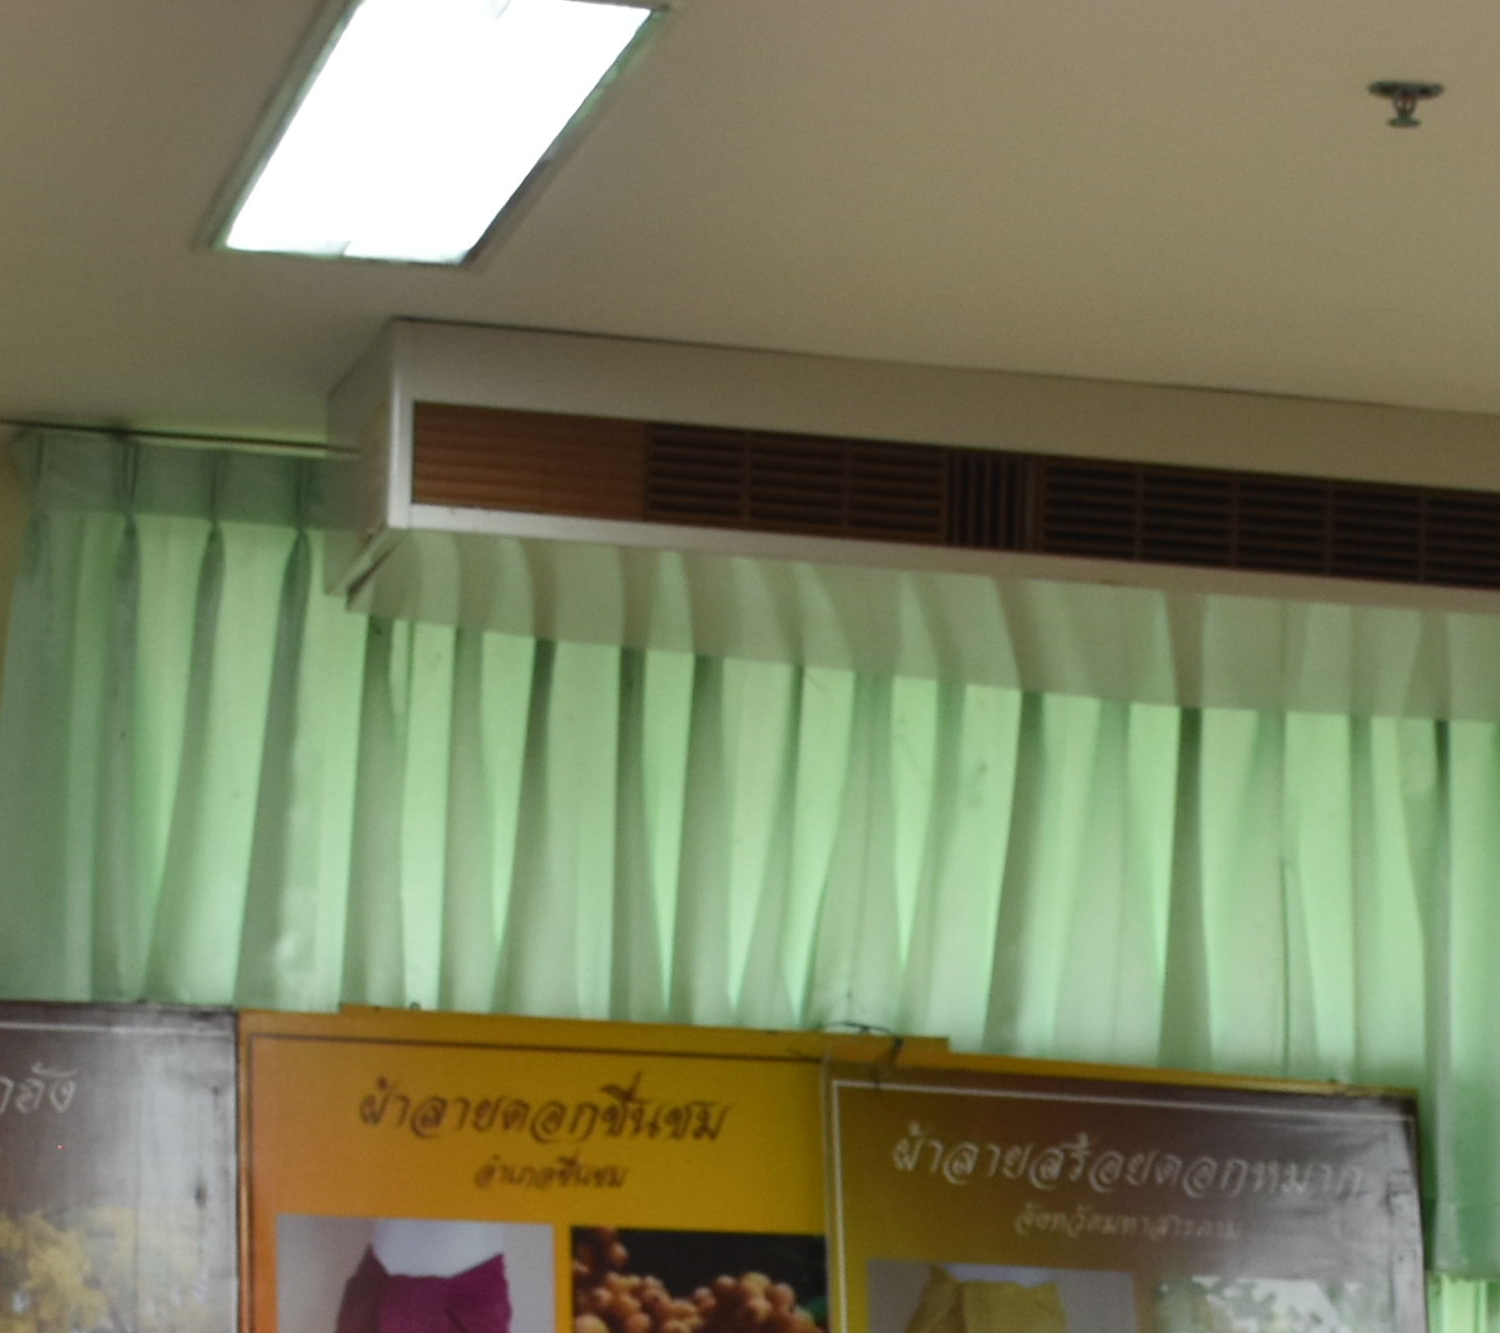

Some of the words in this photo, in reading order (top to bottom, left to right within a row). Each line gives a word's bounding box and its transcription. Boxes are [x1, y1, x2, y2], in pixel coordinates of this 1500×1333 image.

[360, 1072, 730, 1145] ผ้าลายดอกชื่นชม
[892, 1122, 1363, 1199] ผ้าลายสร้อยดอกหมาก
